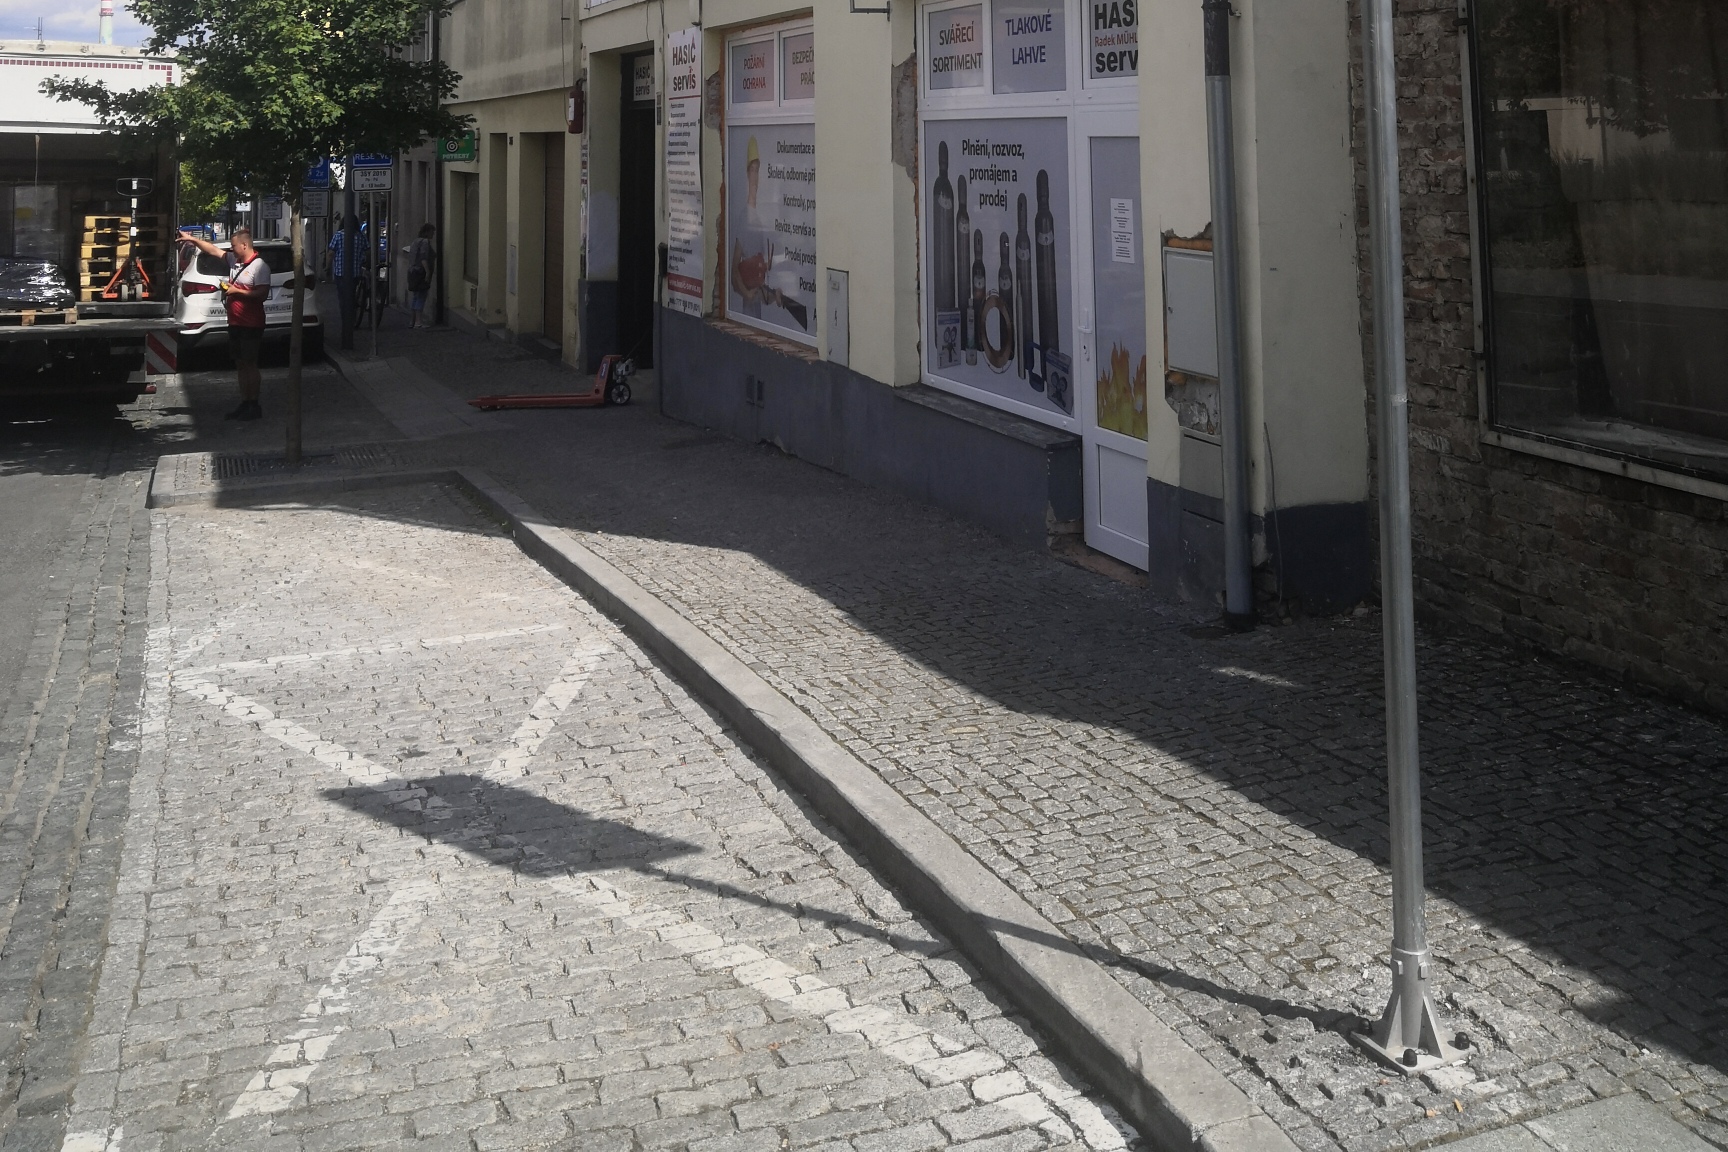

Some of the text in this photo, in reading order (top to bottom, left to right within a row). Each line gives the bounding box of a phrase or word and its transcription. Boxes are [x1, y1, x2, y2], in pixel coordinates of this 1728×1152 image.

[1005, 9, 1052, 36] TLAKOVÉ
[939, 21, 975, 46] SVÁŘECÍ
[1094, 34, 1115, 47] Radek
[743, 53, 765, 70] POŽÁRNÍ
[932, 52, 983, 73] SORTIMENT
[1012, 45, 1047, 65] LAHVE
[1095, 49, 1138, 73] serv
[673, 68, 696, 92] servis
[742, 76, 767, 90] OCHRANA
[776, 140, 811, 154] Dokumentace
[962, 138, 1025, 160] Plnění, rozvoz,
[969, 164, 1018, 186] pronájem a
[979, 189, 1007, 211] prodej
[793, 222, 807, 236] servis
[785, 247, 801, 265] Prodej
